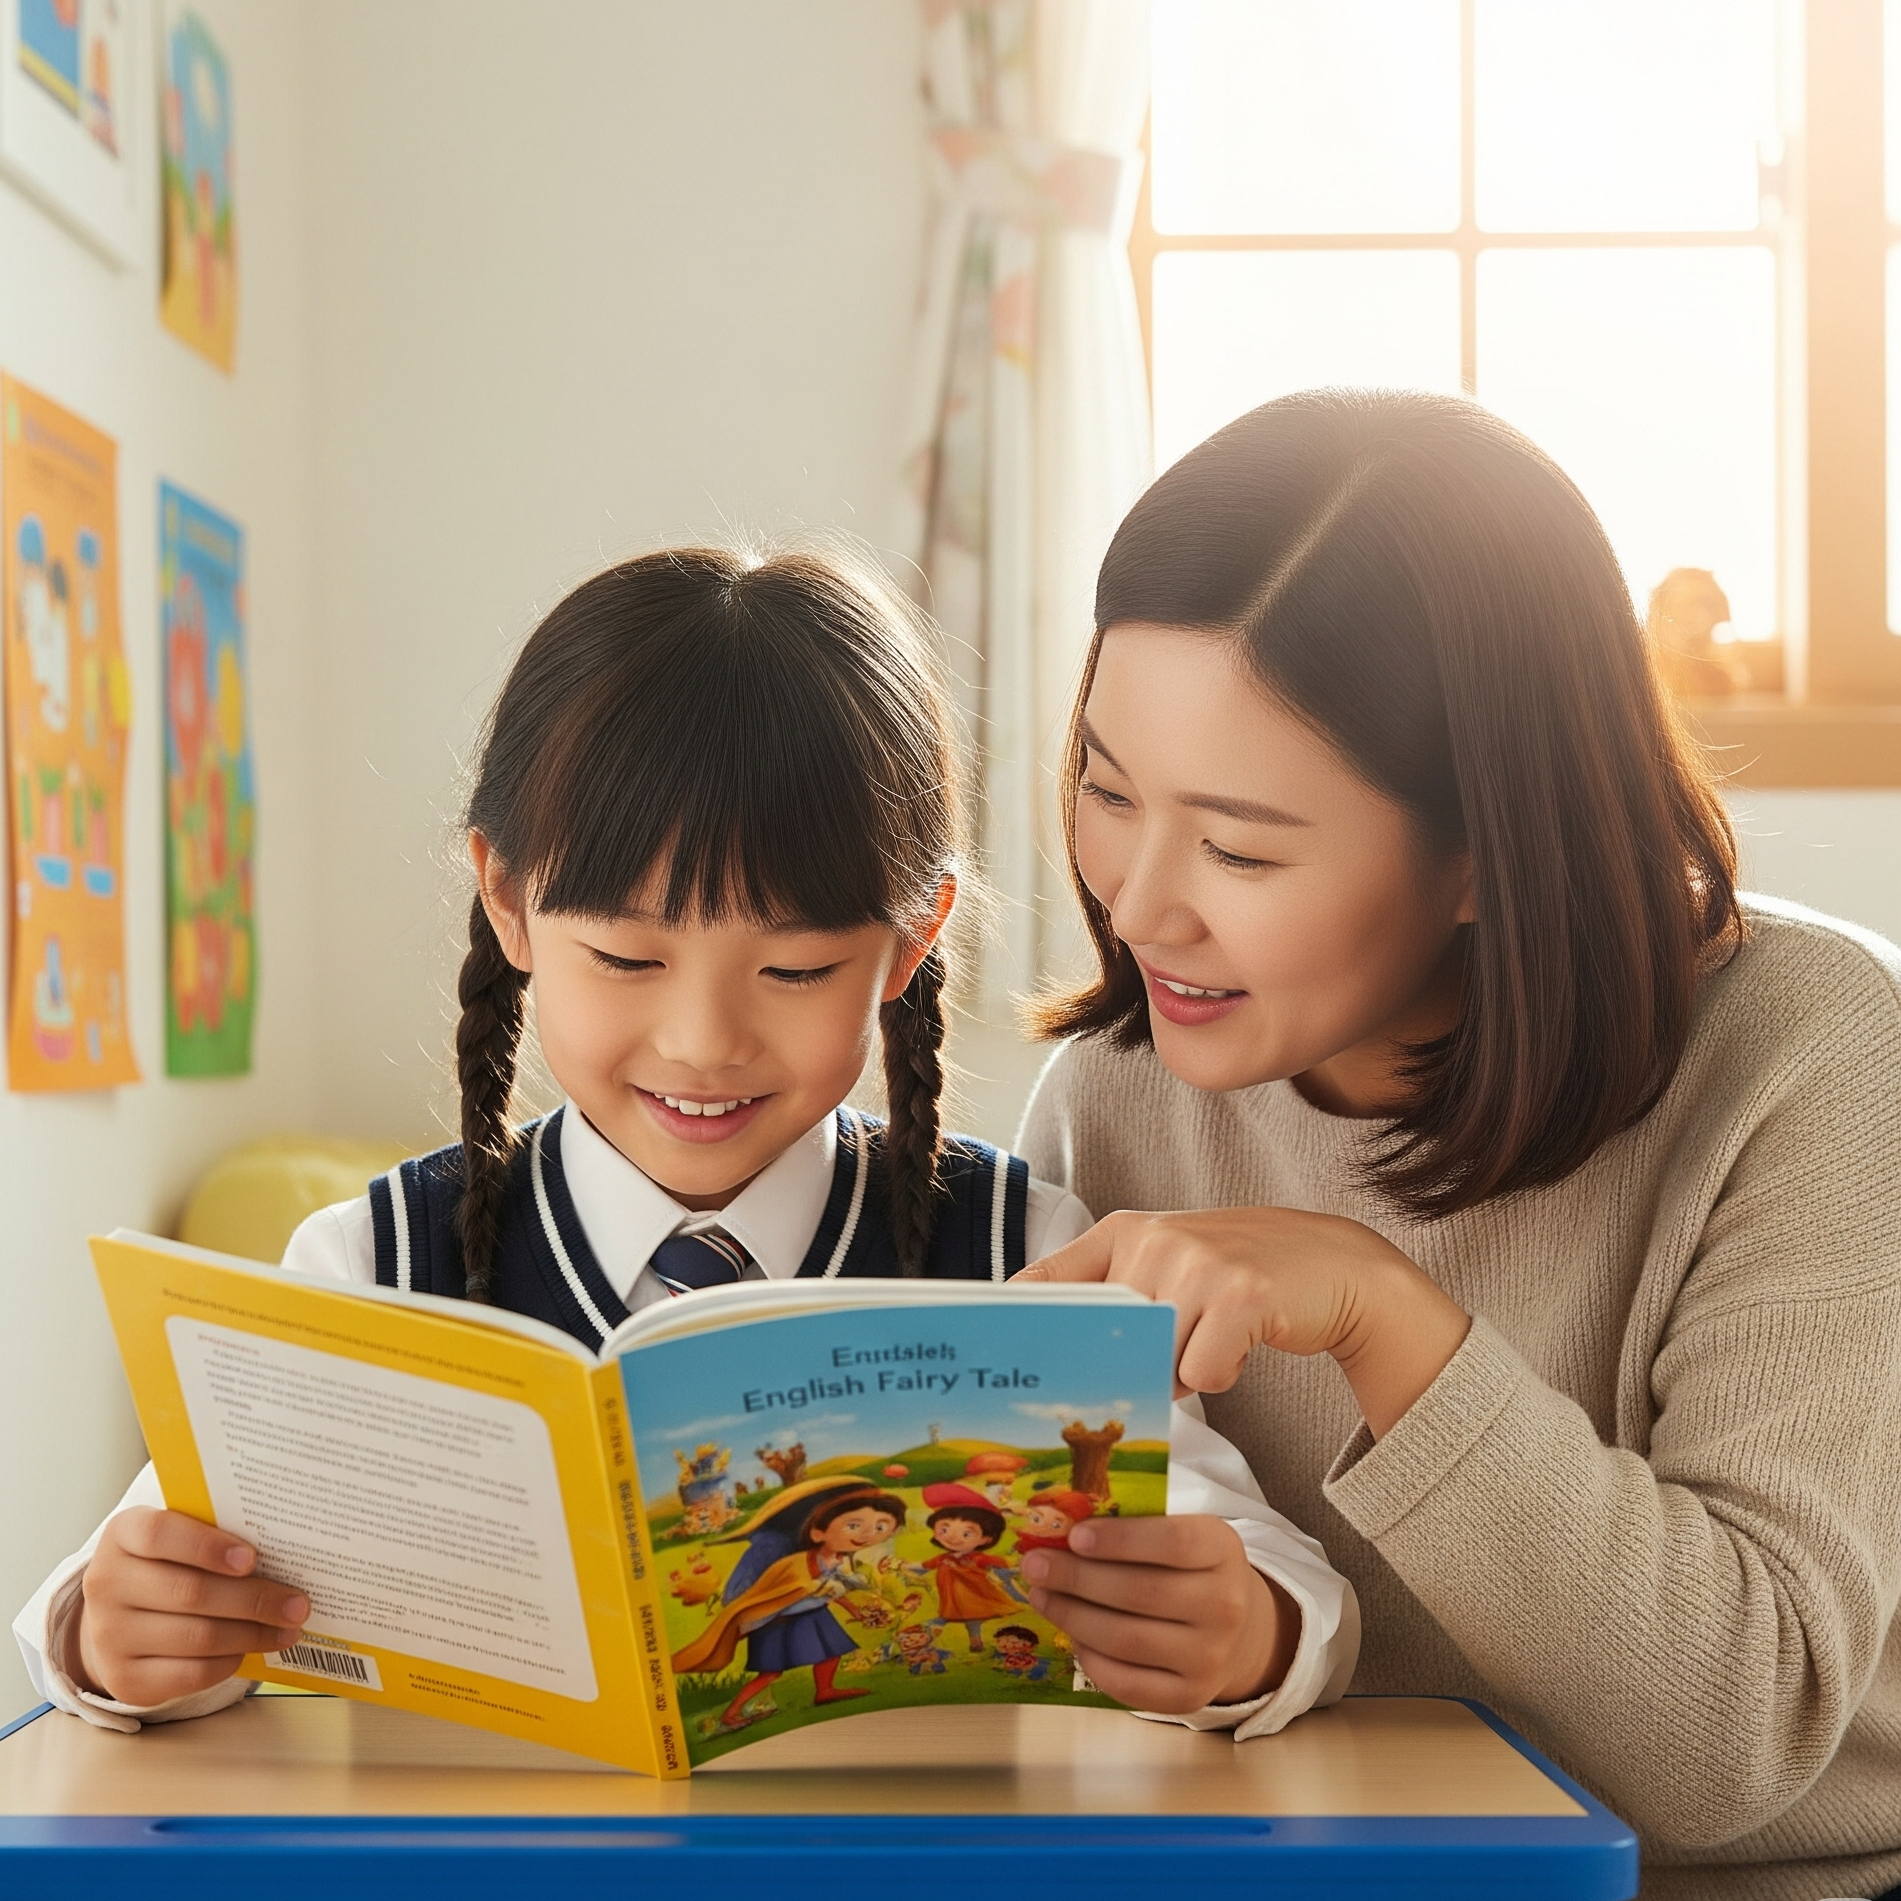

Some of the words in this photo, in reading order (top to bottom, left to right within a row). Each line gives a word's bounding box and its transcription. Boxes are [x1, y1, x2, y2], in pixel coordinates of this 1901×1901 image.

[743, 1375, 865, 1413] English
[877, 1369, 959, 1395] Fairy
[968, 1368, 1040, 1389] Tale
